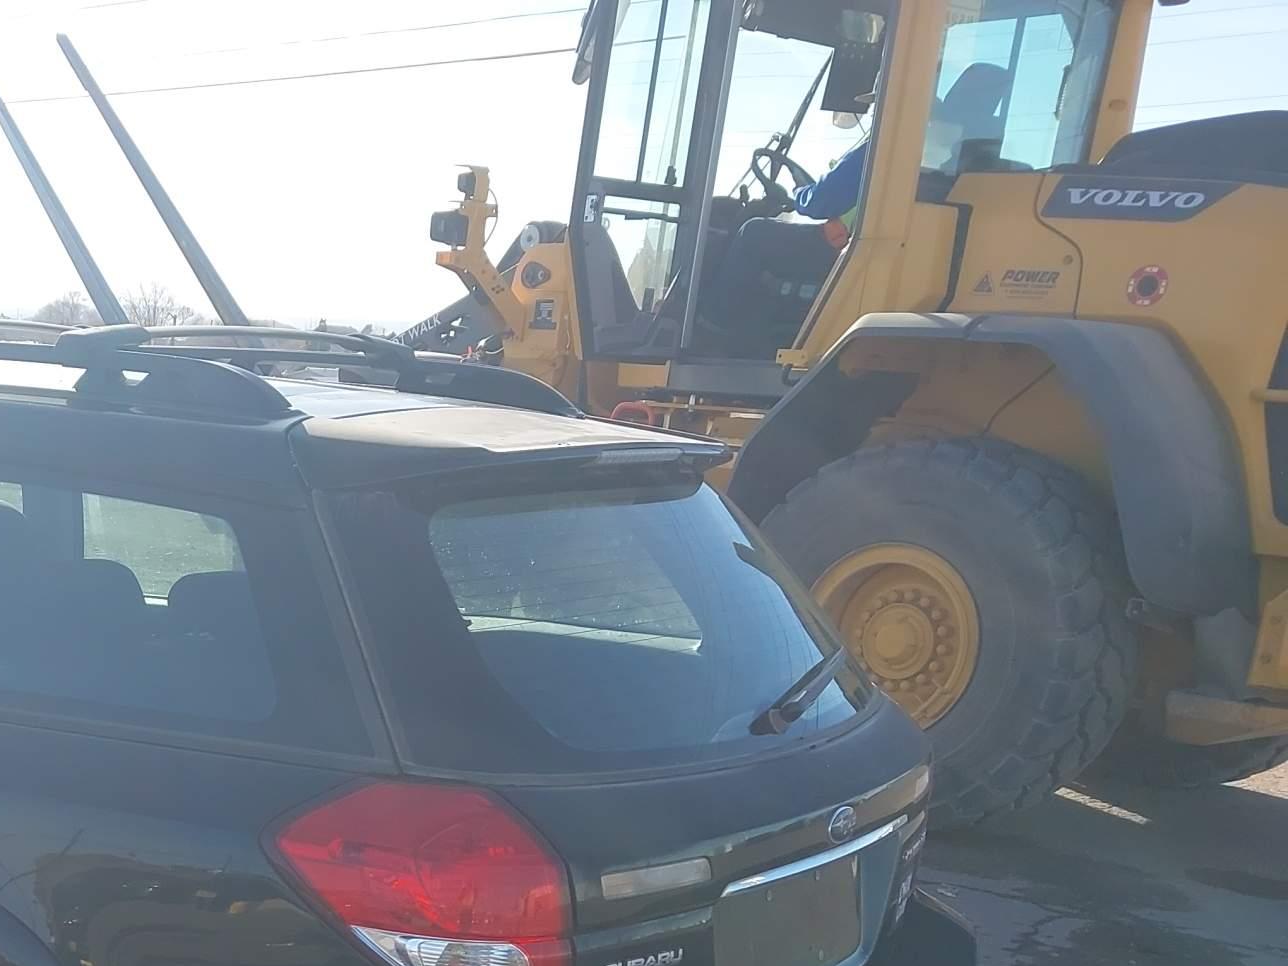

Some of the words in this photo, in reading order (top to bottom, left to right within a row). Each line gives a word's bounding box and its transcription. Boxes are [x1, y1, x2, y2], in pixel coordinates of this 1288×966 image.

[1067, 188, 1205, 208] VOLVO
[1001, 270, 1060, 283] POWER
[408, 312, 441, 340] WALK
